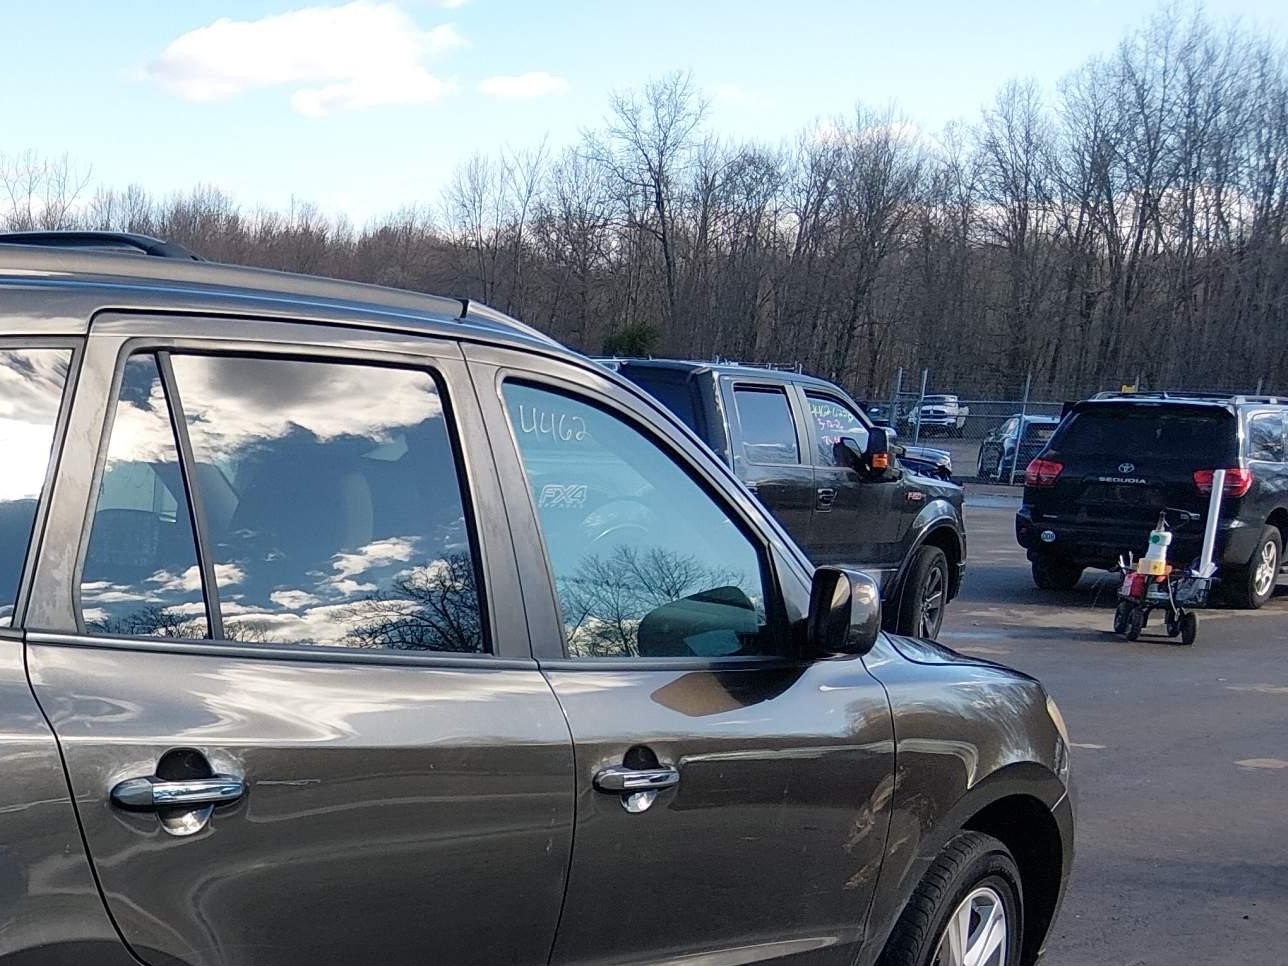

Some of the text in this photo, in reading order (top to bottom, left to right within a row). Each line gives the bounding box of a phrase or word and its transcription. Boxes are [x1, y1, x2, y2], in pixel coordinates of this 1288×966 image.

[519, 405, 590, 446] 4462
[1097, 476, 1147, 485] SEQUOIA
[538, 484, 588, 506] FX4
